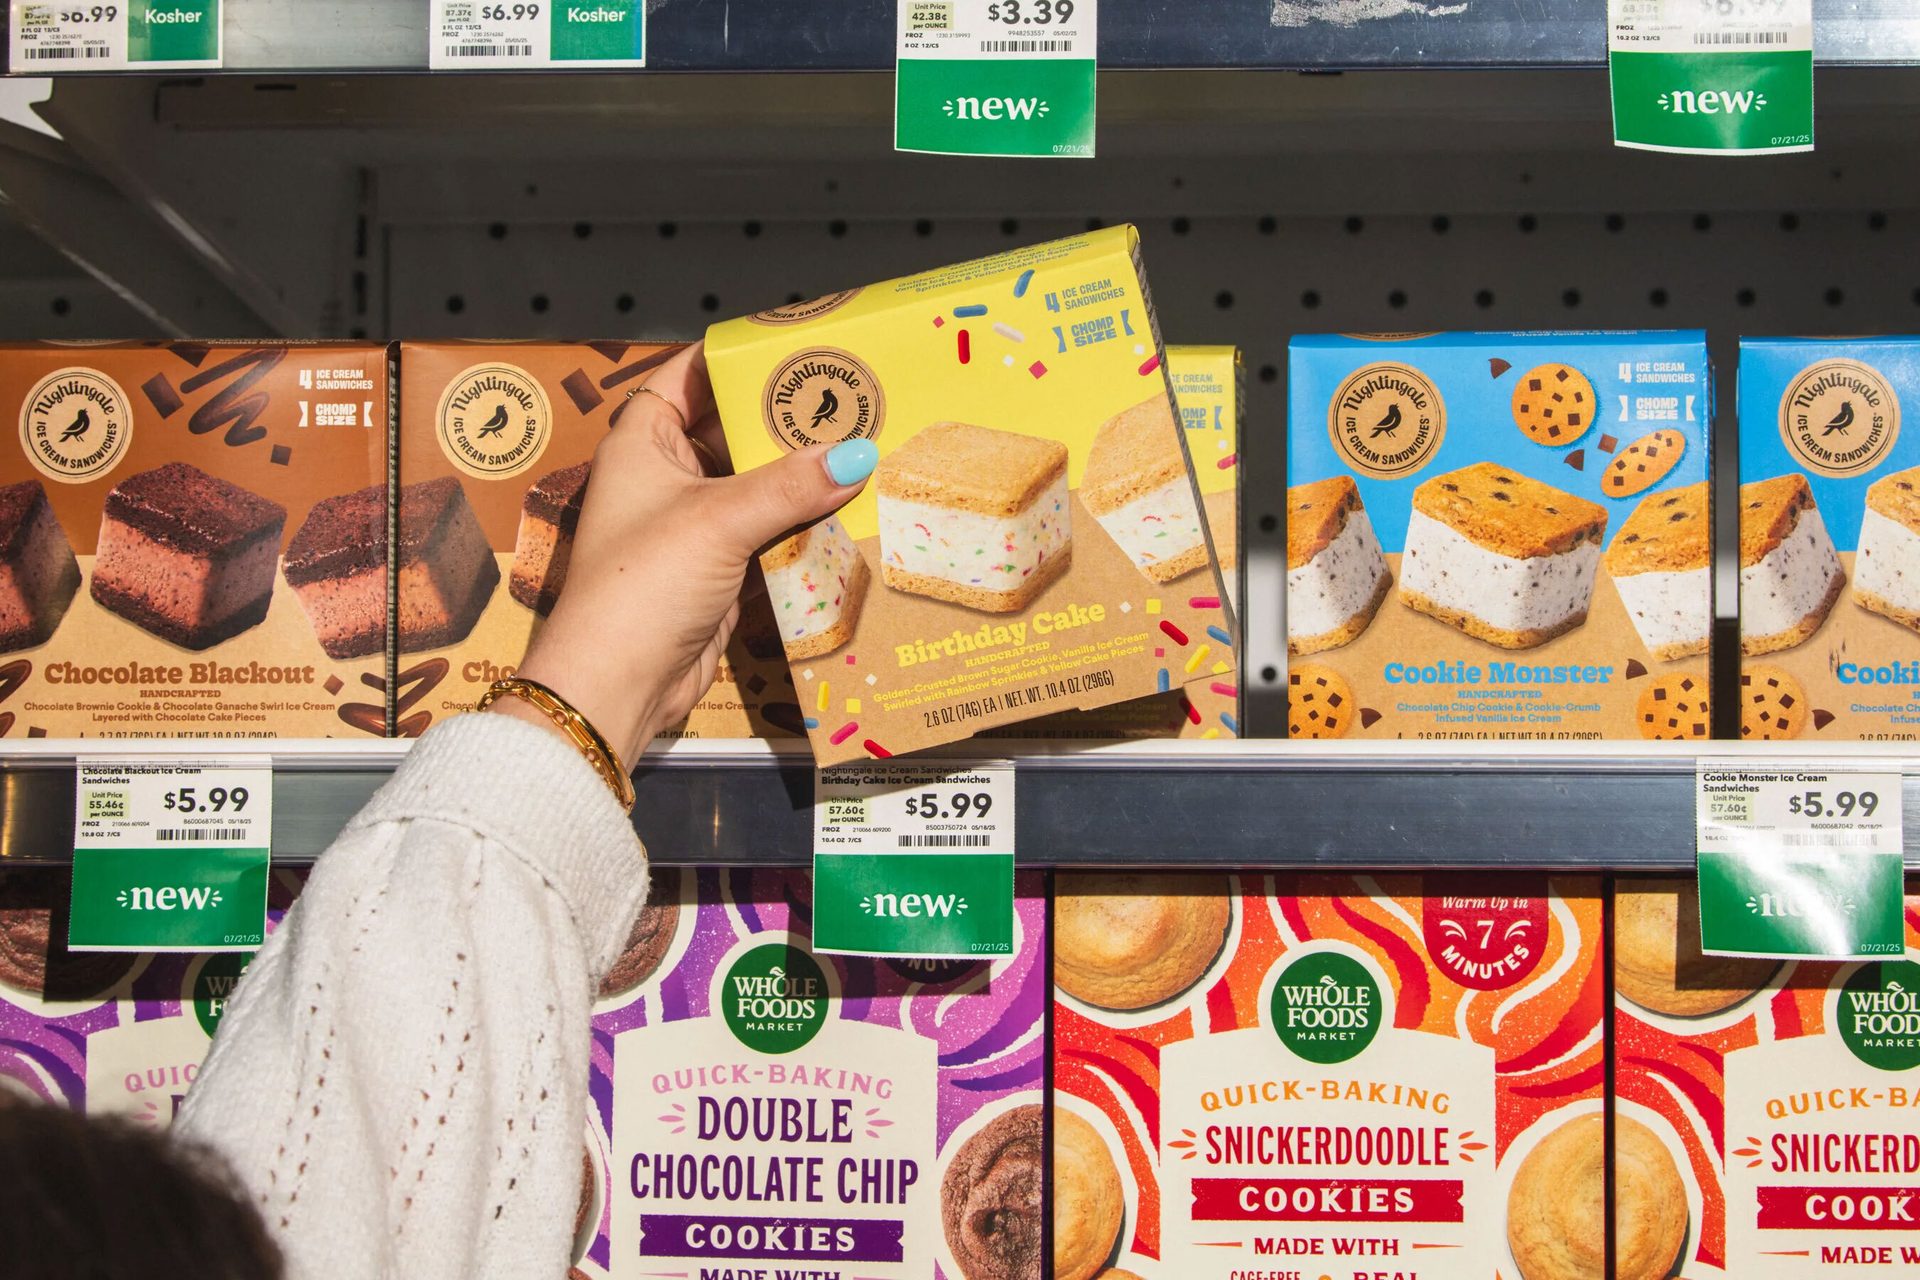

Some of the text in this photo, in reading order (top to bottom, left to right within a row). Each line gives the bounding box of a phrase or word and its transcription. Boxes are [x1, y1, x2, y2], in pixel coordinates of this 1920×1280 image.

[145, 9, 202, 23] Kosher
[482, 4, 539, 20] $6.99
[568, 8, 626, 22] Kosher
[912, 13, 947, 21] 42.38¢
[988, 0, 1074, 24] $3.39
[957, 98, 1037, 120] new
[1671, 91, 1754, 113] new
[1772, 135, 1809, 144] 07/21/25
[1062, 278, 1112, 299] ICE CREAM
[1065, 287, 1125, 310] SANDWICHES
[1045, 292, 1060, 313] 4
[1071, 316, 1114, 337] CHOMP
[1074, 329, 1117, 347] SIZE
[317, 370, 363, 379] ICE CREAM
[1619, 363, 1631, 383] 4
[1636, 362, 1685, 372] ICE CREAM
[299, 369, 312, 389] 4
[316, 380, 373, 390] SANDWICHES
[776, 361, 860, 406] Nightingale
[1636, 373, 1695, 383] SANDWICHES
[34, 381, 115, 415] Nightingale
[451, 376, 533, 412] Nightingale
[1343, 375, 1427, 411] Nightingale
[1795, 372, 1880, 408] Nightingale
[316, 403, 357, 416] CHOMP
[1636, 398, 1678, 409] CHOMP
[316, 416, 357, 426] SIZE
[782, 411, 796, 429] ICE
[1636, 410, 1678, 420] SIZE
[37, 422, 116, 469] ICE CREAM SANDWICHES
[1346, 416, 1430, 465] ICE CREAM SANDWICHES
[894, 603, 1105, 668] Birthday Cake
[964, 641, 1050, 668] HANDCRAFTED
[44, 661, 315, 685] Chocolate Blackout
[873, 632, 1149, 702] Golden-Crusted Brown Sugar Cookie, Vanilla Ice Cream
[1384, 660, 1613, 684] Cookie Monster
[883, 645, 1144, 712] Swirled with Rainbow Sprinkles & Yellow Cake Pieces
[140, 689, 221, 698] HANDCRAFTED
[924, 669, 1114, 728] 2.6 OZ (74G) EA NET. WT. 10.4 OZ (296G)
[1458, 690, 1542, 698] HANDCRAFTED
[24, 702, 74, 711] Chocolate
[76, 702, 114, 711] Brownie
[117, 702, 151, 711] Cookie
[162, 702, 212, 711] Chocolate
[215, 702, 258, 711] Ganache
[260, 702, 284, 711] Swirl
[286, 702, 301, 711] Ice
[303, 702, 335, 711] Cream
[1397, 703, 1601, 714] Chocolate Chip Cookie & Cookie-Crumb
[1851, 704, 1904, 713] Chocolate
[92, 712, 266, 723] Layered with Chocolate Cake Pieces
[1436, 714, 1562, 723] Infused Vanilla Ice Cream
[822, 776, 990, 787] Birthday Cake Ice Cream Sandwiches
[1704, 774, 1827, 782] Cookie Monster Ice Cream
[1704, 784, 1759, 792] Sandwiches
[164, 787, 249, 813] $5.99
[829, 806, 864, 815] 57.60¢
[905, 793, 993, 819] $5.99
[1789, 792, 1879, 818] $5.99
[130, 887, 211, 910] new
[874, 893, 956, 917] new
[1442, 897, 1528, 910] Warm Up in
[1476, 920, 1494, 949] 7
[971, 943, 1009, 951] 07/21/25
[1441, 944, 1529, 979] MINUTES
[733, 976, 817, 997] WHOLE
[1282, 986, 1370, 1007] WHOLE
[737, 999, 816, 1019] FOODS
[1848, 992, 1920, 1012] WHOL
[746, 1023, 803, 1031] MARKET
[1288, 1008, 1368, 1028] FOODS
[1854, 1014, 1920, 1034] FOOD
[1297, 1032, 1356, 1041] MARKET
[652, 1063, 893, 1099] QUICK-BAKING
[1200, 1080, 1450, 1114] QUICK-BAKING
[697, 1096, 853, 1143] DOUBLE
[1206, 1125, 1449, 1165] SNICKERDOODLE
[1771, 1134, 1920, 1172] SNICKERD
[630, 1153, 919, 1204] CHOCOLATE CHIP
[1239, 1187, 1414, 1213] COOKIES
[1806, 1194, 1914, 1221] COOK
[685, 1223, 855, 1252] COOKIES
[1254, 1238, 1399, 1256] MADE WITH
[1821, 1246, 1892, 1264] MADE
